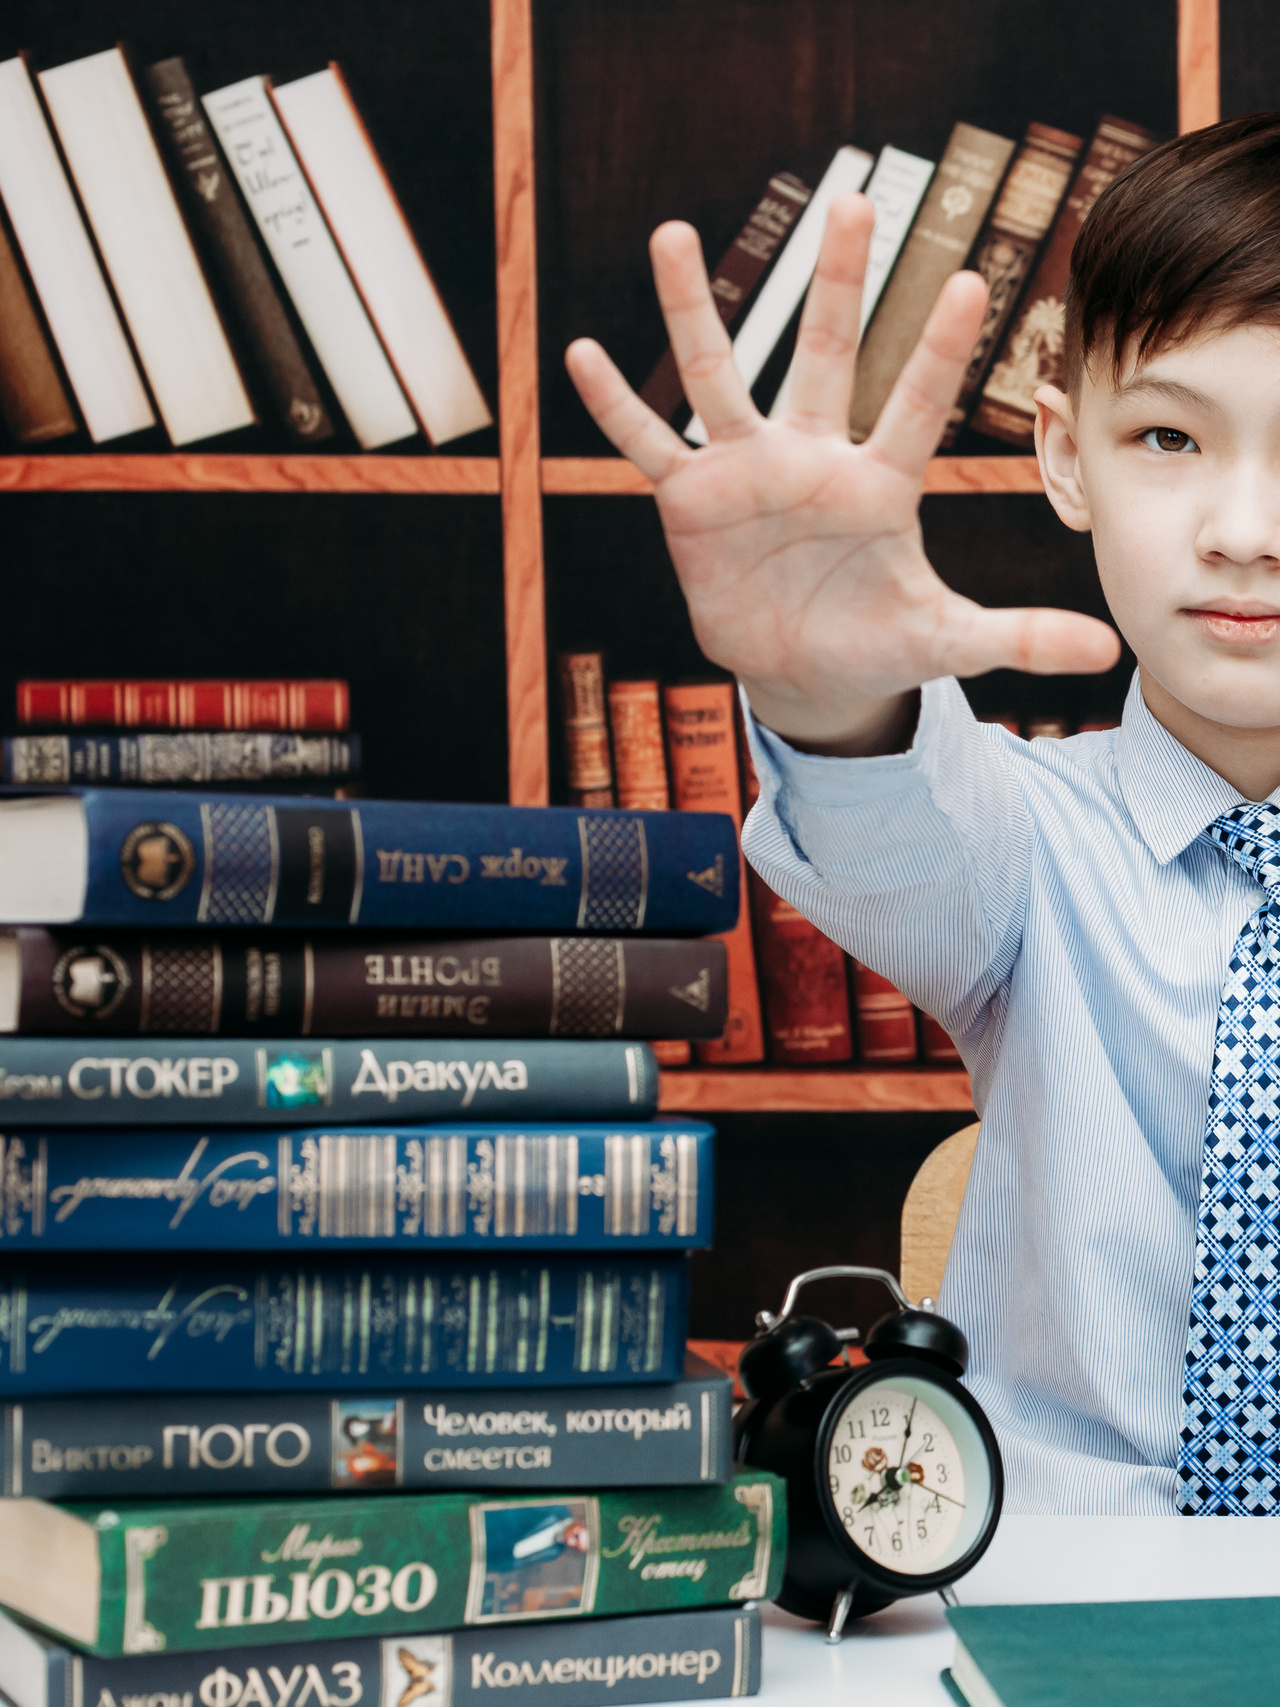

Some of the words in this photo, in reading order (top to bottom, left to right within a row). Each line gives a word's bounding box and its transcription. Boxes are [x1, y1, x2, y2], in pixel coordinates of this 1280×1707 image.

[375, 848, 471, 884] САНД
[479, 847, 569, 887] Жорж
[364, 954, 502, 987] БРОНТЕ
[376, 993, 492, 1026] Эмили
[0, 1067, 63, 1101] рэм
[68, 1057, 240, 1100] СТОКЕР
[351, 1048, 529, 1108] Дракула
[422, 1403, 558, 1438] Человек,
[566, 1401, 692, 1441] который
[848, 1420, 867, 1440] 11
[871, 1407, 891, 1428] 12
[31, 1438, 154, 1474] Виктор
[162, 1422, 312, 1470] ГЮГО
[422, 1444, 553, 1473] смеется
[834, 1444, 853, 1465] 10
[923, 1432, 935, 1453] 2
[936, 1463, 948, 1484] 3
[842, 1506, 855, 1528] 8
[916, 1519, 929, 1540] 5
[863, 1526, 876, 1547] 7
[891, 1530, 904, 1553] 6
[195, 1561, 438, 1630] ПЬЮЗО
[199, 1660, 364, 1707] ФАУЛЗ
[471, 1648, 722, 1690] Коллекционер
